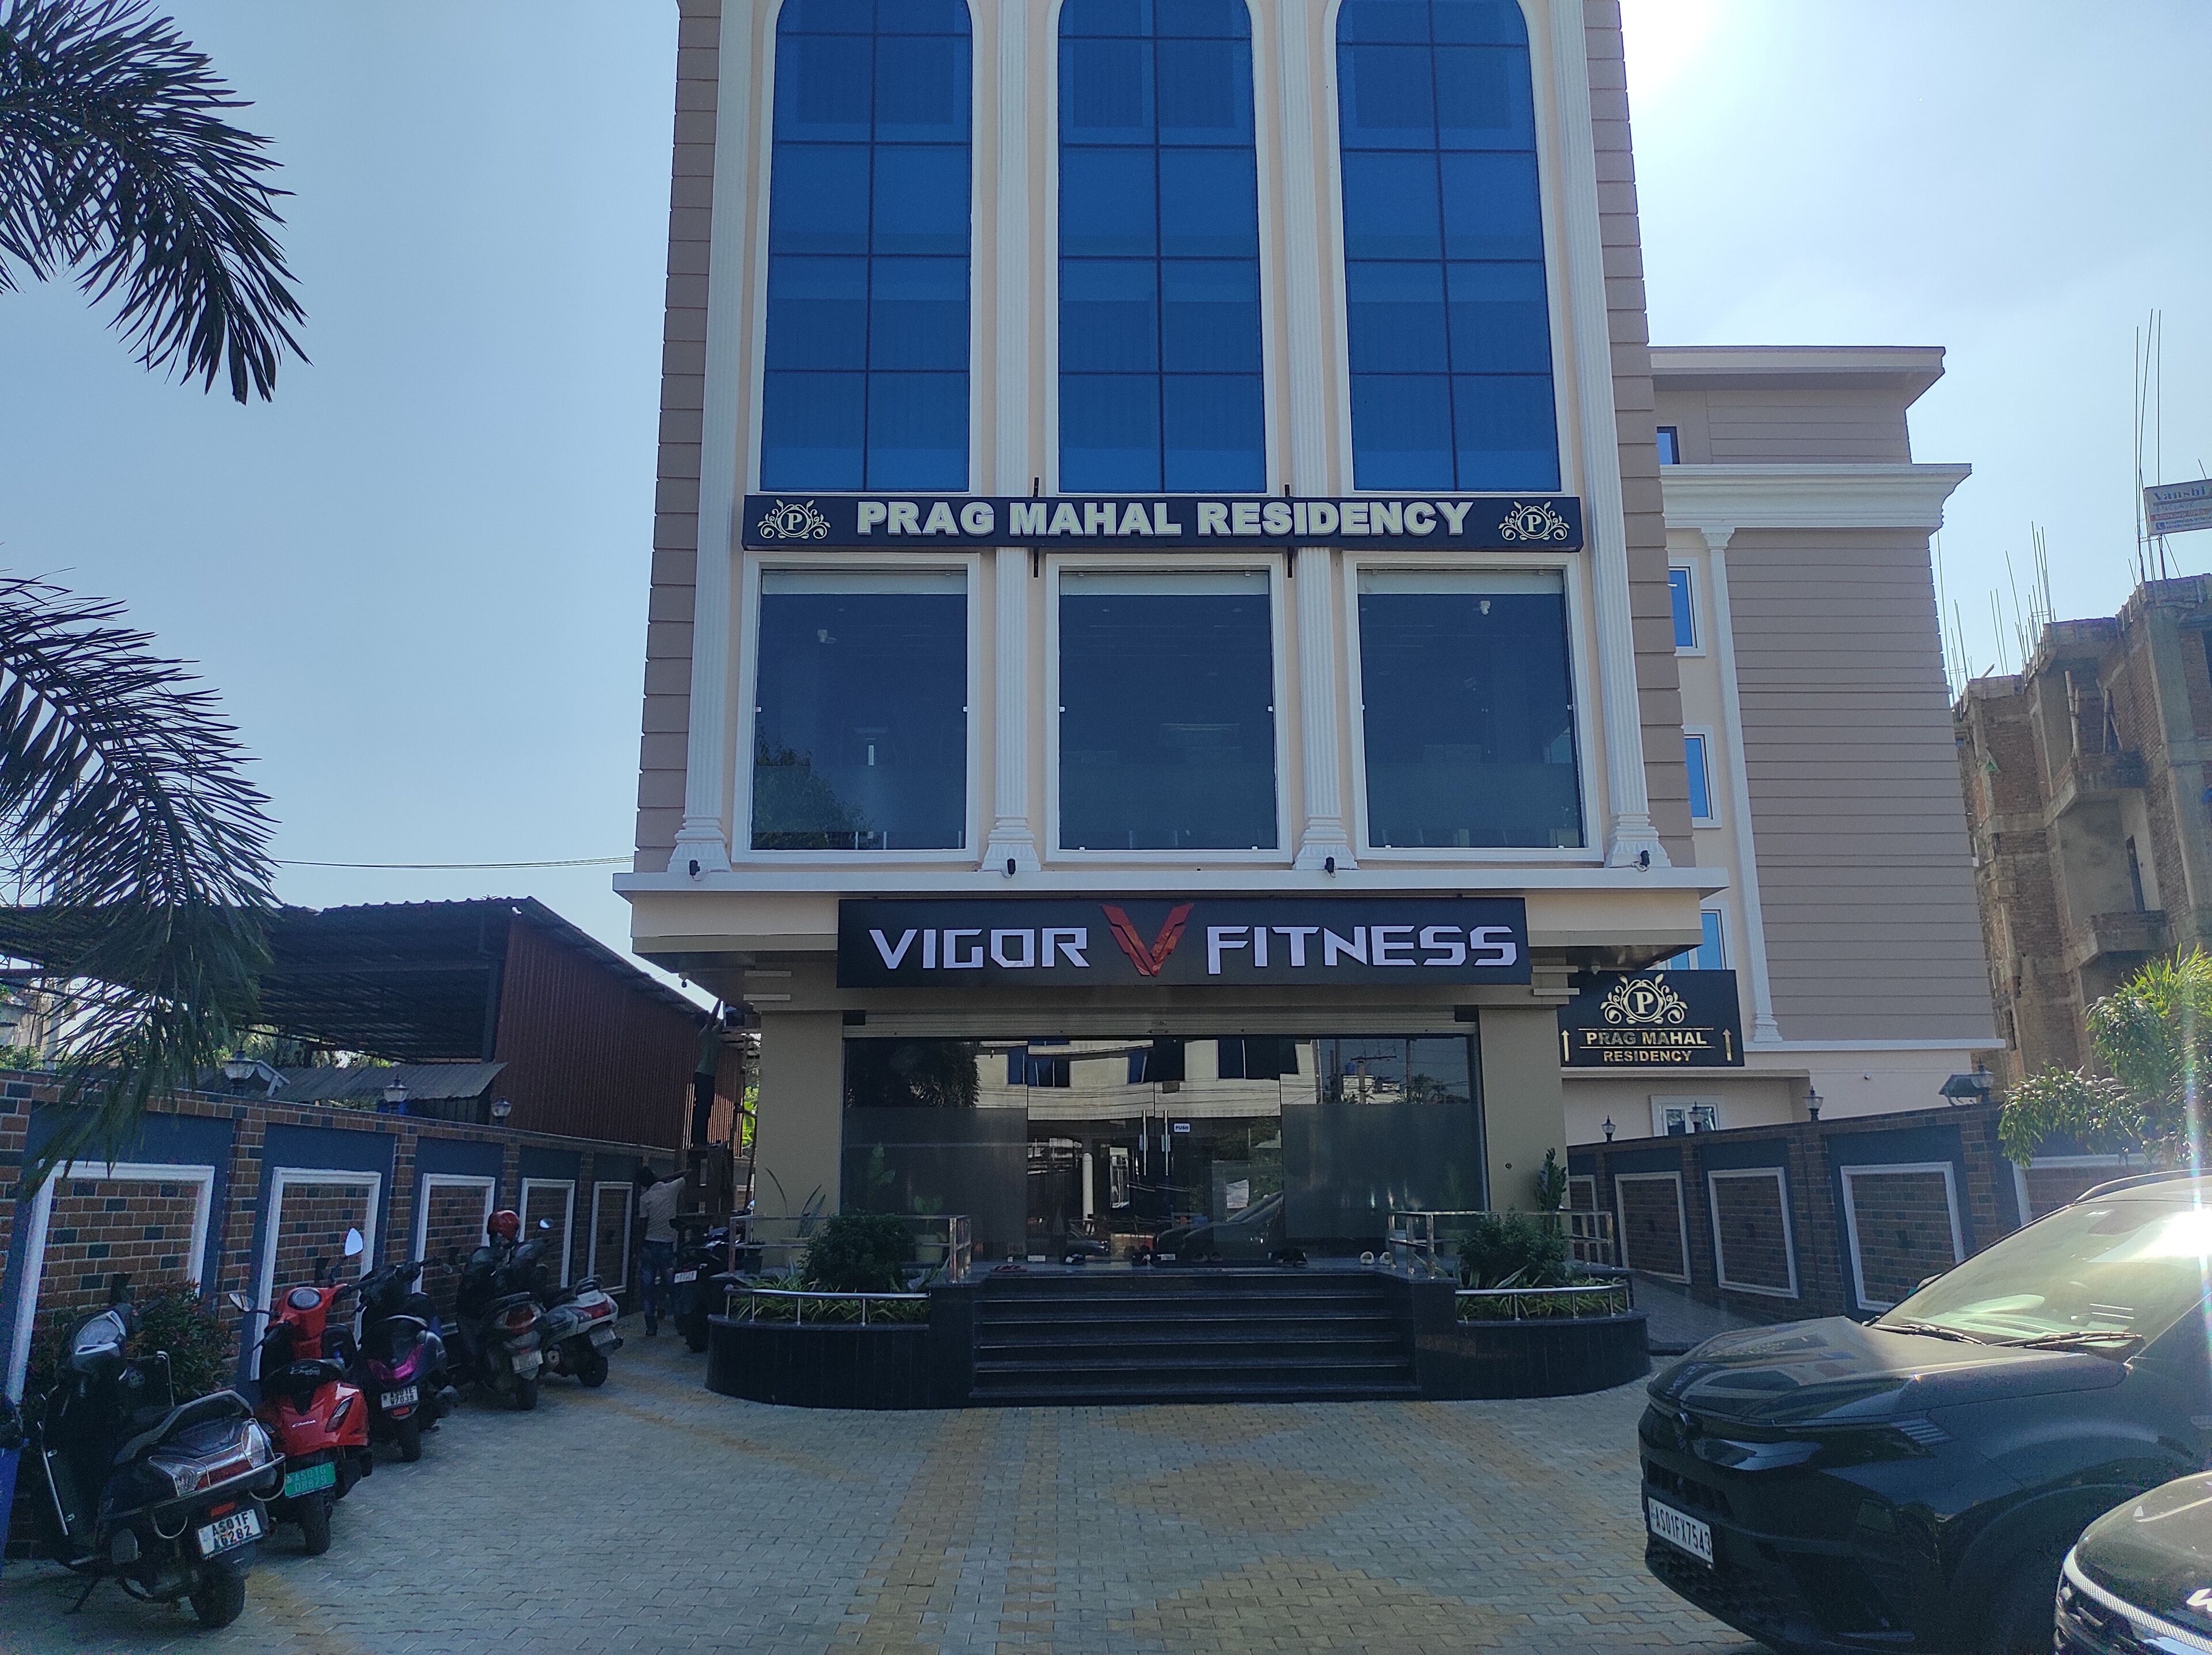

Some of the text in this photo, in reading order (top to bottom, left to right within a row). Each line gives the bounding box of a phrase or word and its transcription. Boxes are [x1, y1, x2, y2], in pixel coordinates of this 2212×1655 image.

[2154, 486, 2205, 500] Vanshi
[857, 501, 1474, 537] PRAG MAHAL RESIDENCY
[869, 927, 1090, 969] VIGOR
[1207, 926, 1517, 975] FITNESS
[1586, 1032, 1707, 1045] PRAG MAHAL
[1603, 1050, 1691, 1062] RESIDENCY
[212, 1512, 249, 1536] AS01F
[1656, 1506, 1711, 1556] AS01FX7543
